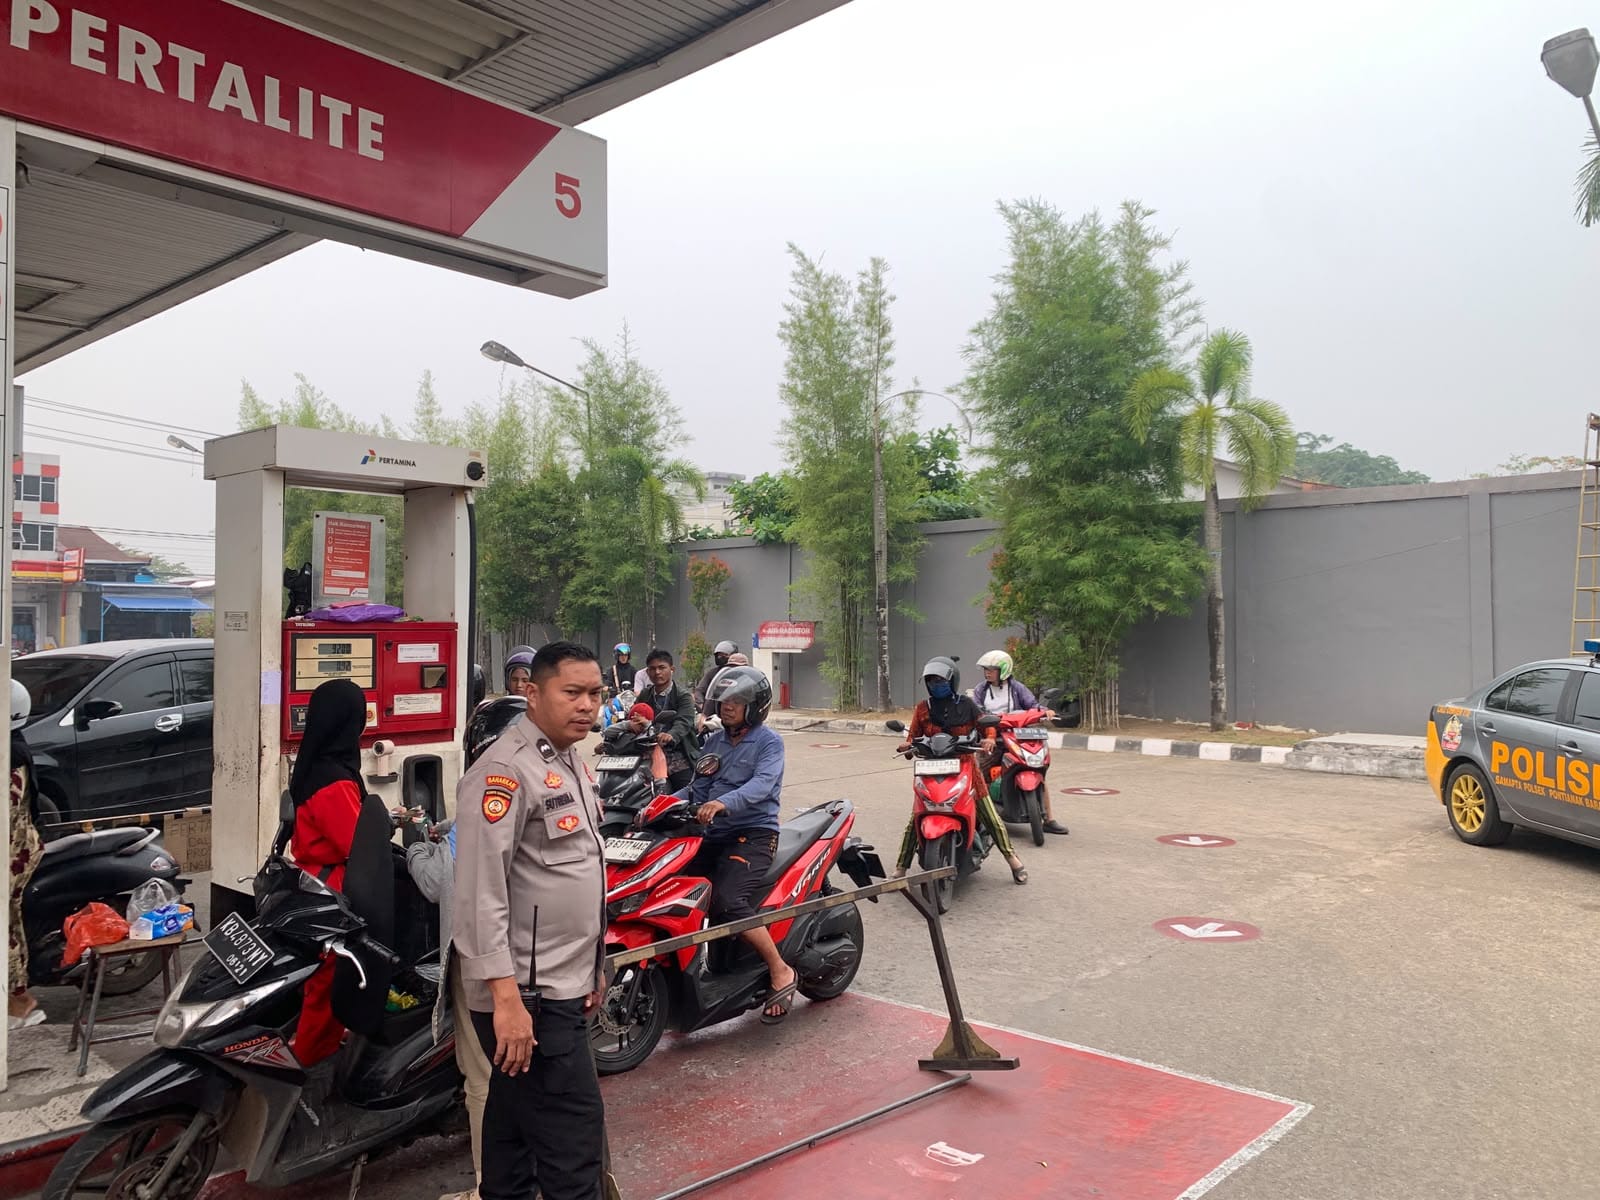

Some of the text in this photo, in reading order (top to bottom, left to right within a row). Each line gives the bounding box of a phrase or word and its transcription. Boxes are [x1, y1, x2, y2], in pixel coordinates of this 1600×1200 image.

[10, 0, 385, 161] PERTALITE
[555, 172, 581, 219] 5
[379, 457, 416, 467] PERTAMINA
[1491, 741, 1600, 801] POLISI
[1495, 776, 1522, 790] SAMAPTA
[1523, 782, 1546, 796] POLSEK
[655, 881, 681, 898] HONDA
[224, 1035, 270, 1053] HONDA
